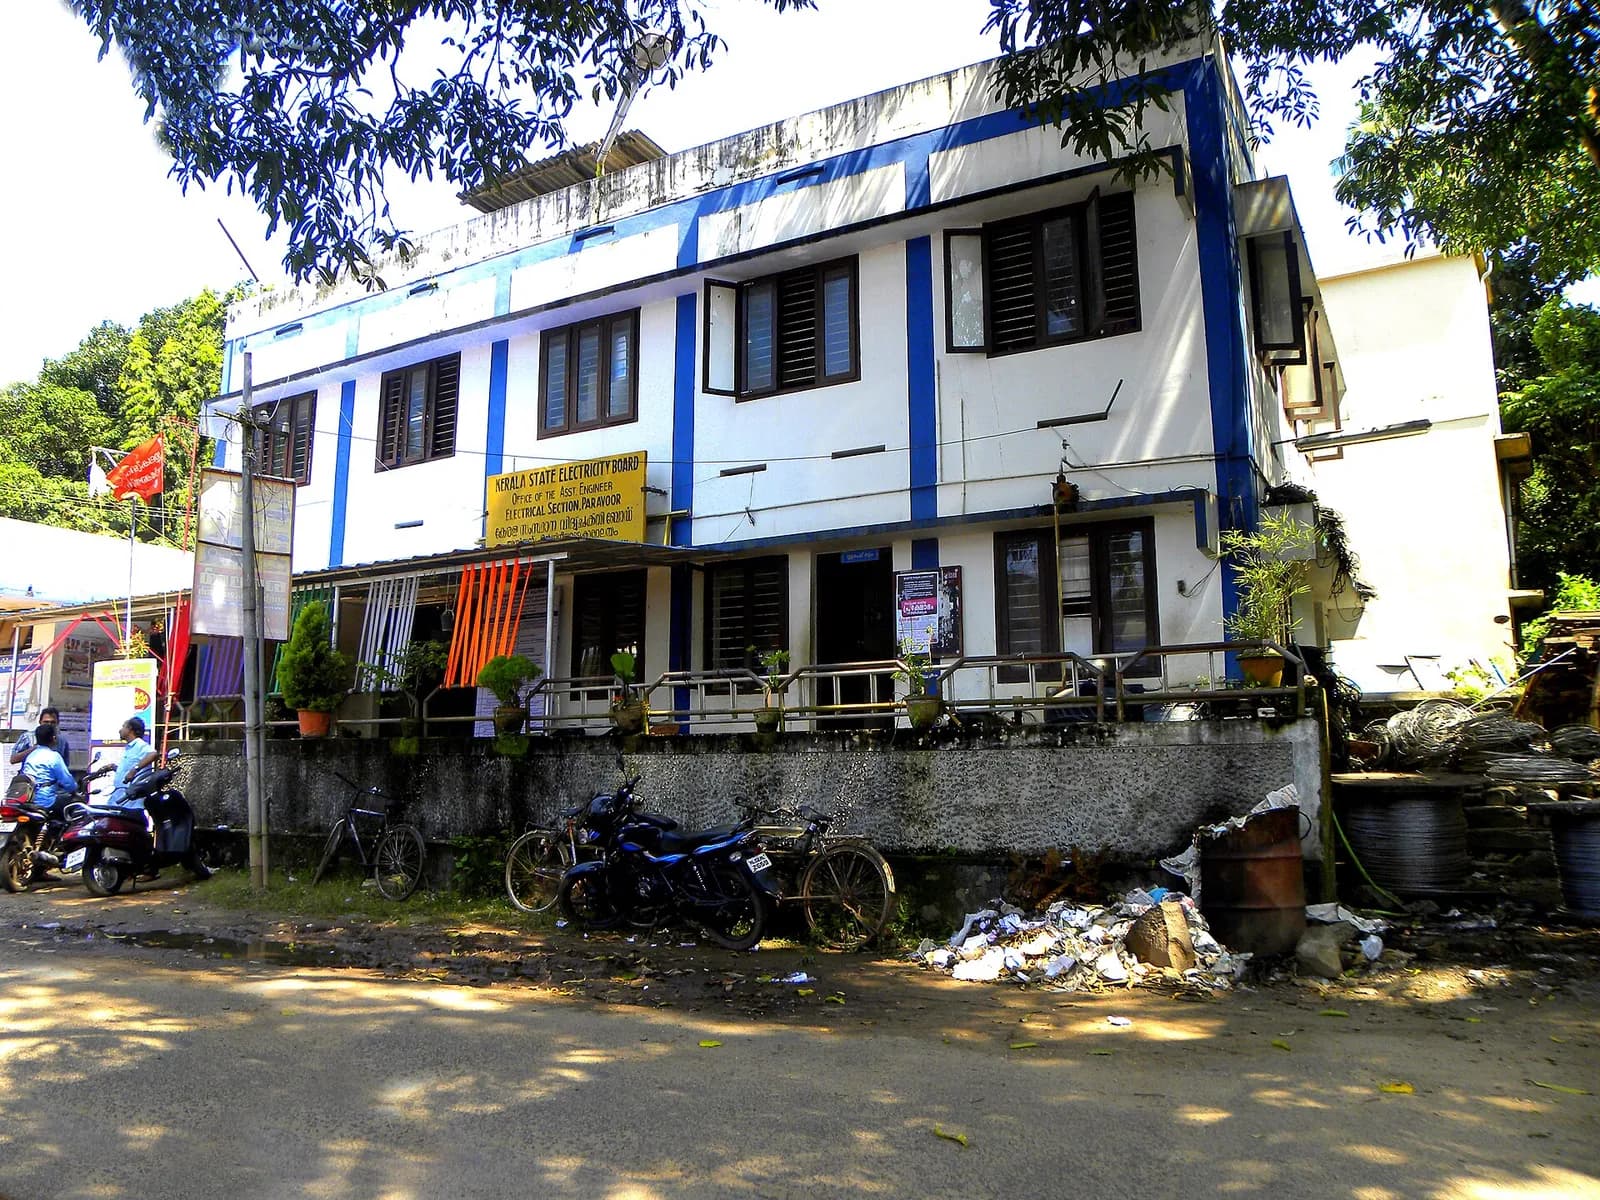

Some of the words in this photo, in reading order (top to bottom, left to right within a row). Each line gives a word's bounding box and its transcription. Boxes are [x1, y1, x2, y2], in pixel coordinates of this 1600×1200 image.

[495, 474, 526, 492] KERALA
[529, 469, 556, 487] STATE
[559, 460, 611, 482] ELECTRICITY
[612, 456, 639, 474] BOARD
[580, 481, 613, 496] ENGINEER
[505, 504, 545, 521] ELECTRICAL
[582, 494, 621, 510] PARAVOOR
